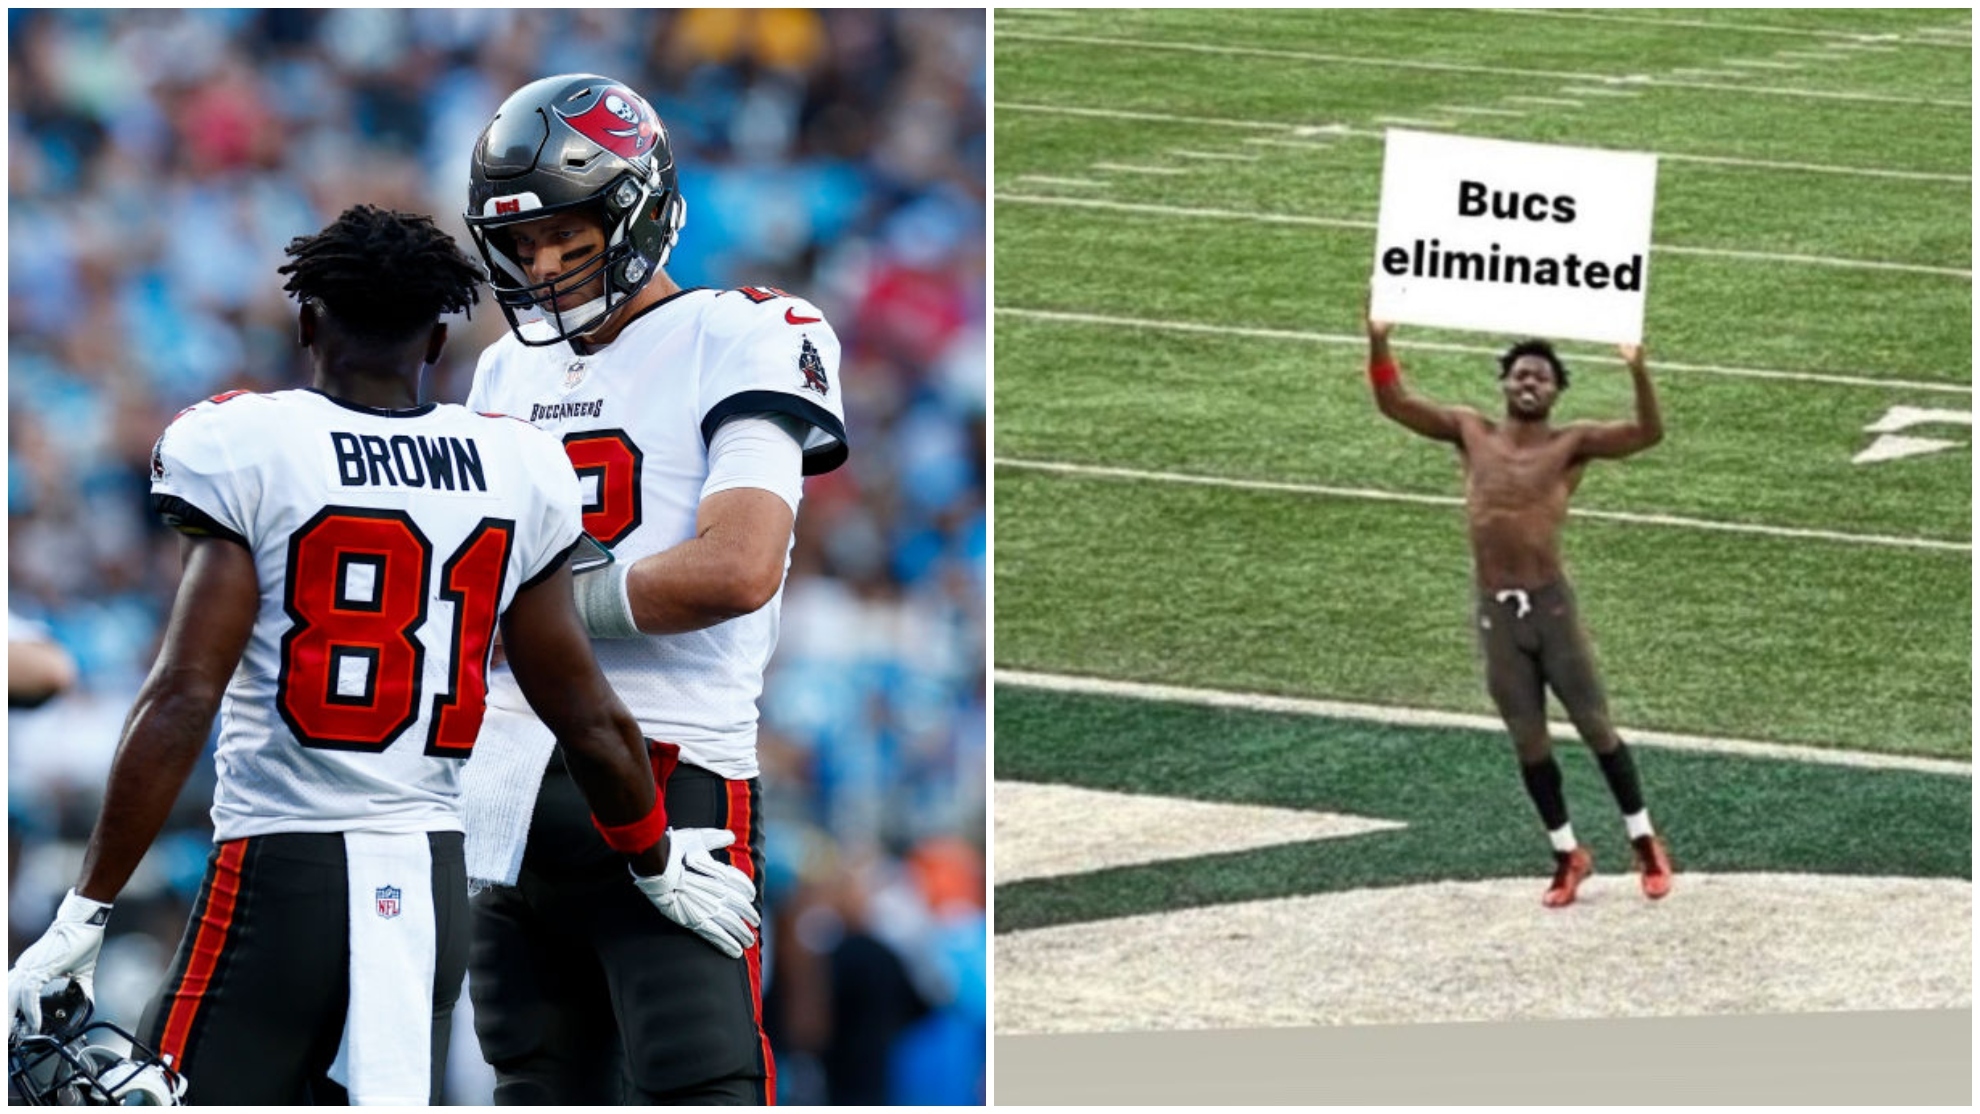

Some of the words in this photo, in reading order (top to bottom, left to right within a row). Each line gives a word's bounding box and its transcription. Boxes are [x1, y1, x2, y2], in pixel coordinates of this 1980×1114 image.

[1457, 179, 1577, 224] Bucs
[1381, 237, 1643, 292] eliminated
[330, 431, 487, 492] BROWN
[276, 504, 517, 760] 81
[378, 899, 399, 916] NFL
